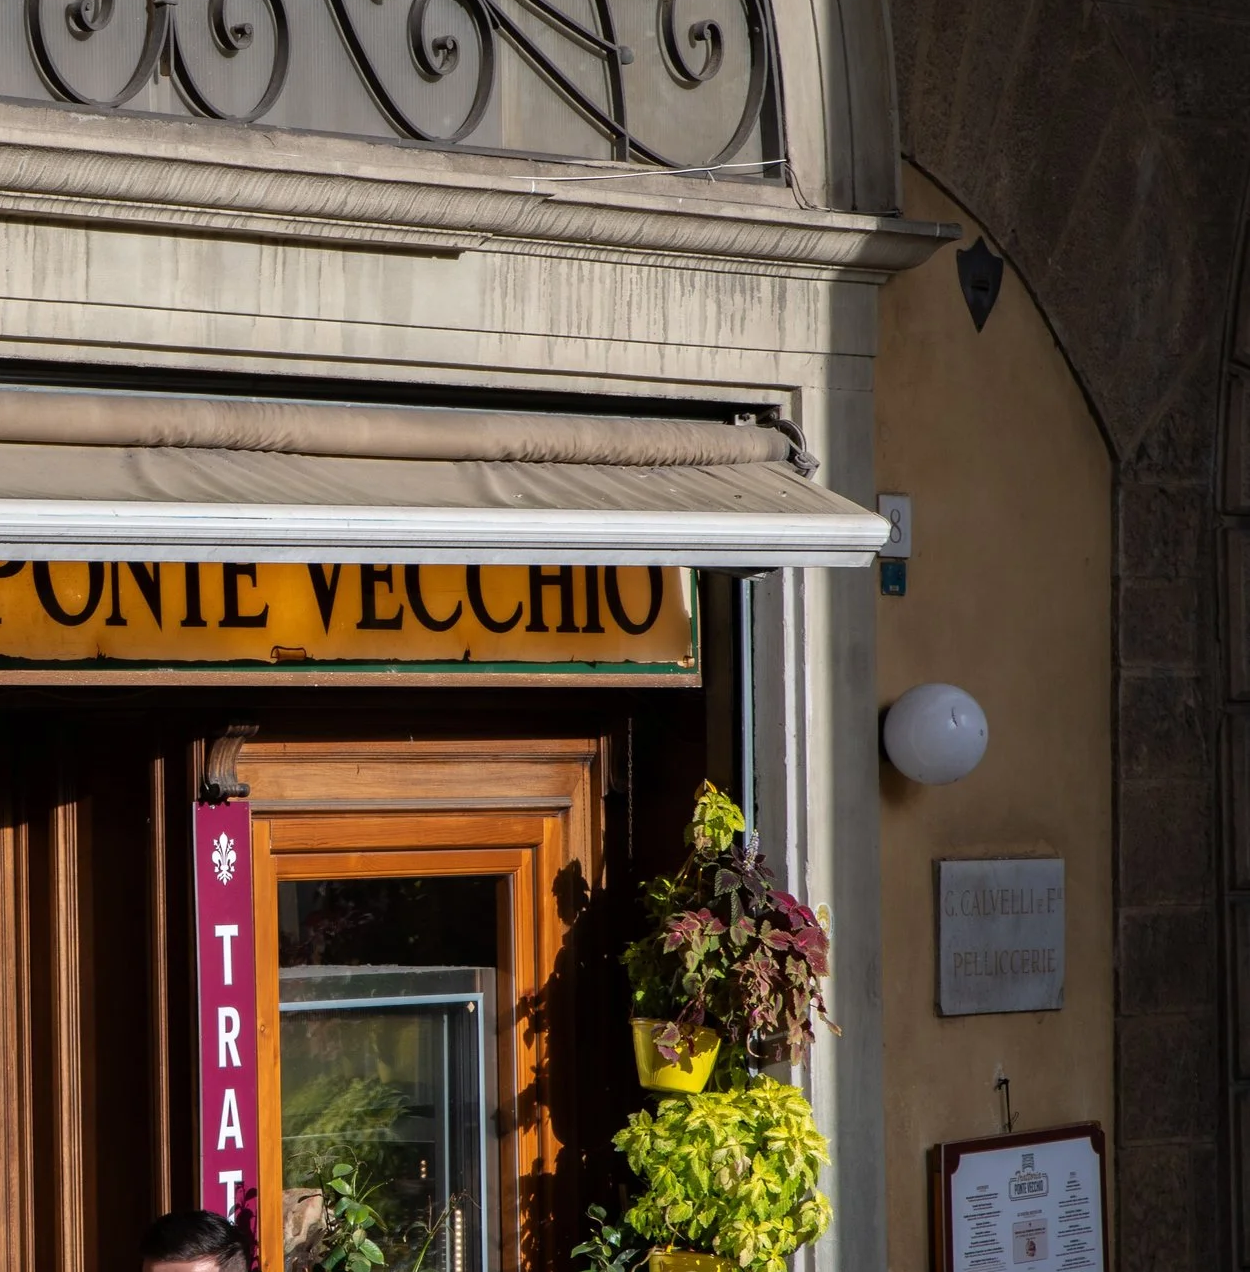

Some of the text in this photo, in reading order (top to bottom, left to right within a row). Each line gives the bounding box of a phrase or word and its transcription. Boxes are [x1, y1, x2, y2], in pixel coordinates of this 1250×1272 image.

[890, 508, 902, 544] 8
[303, 563, 664, 635] VECCHIO
[953, 948, 1056, 978] PELLICCERIE
